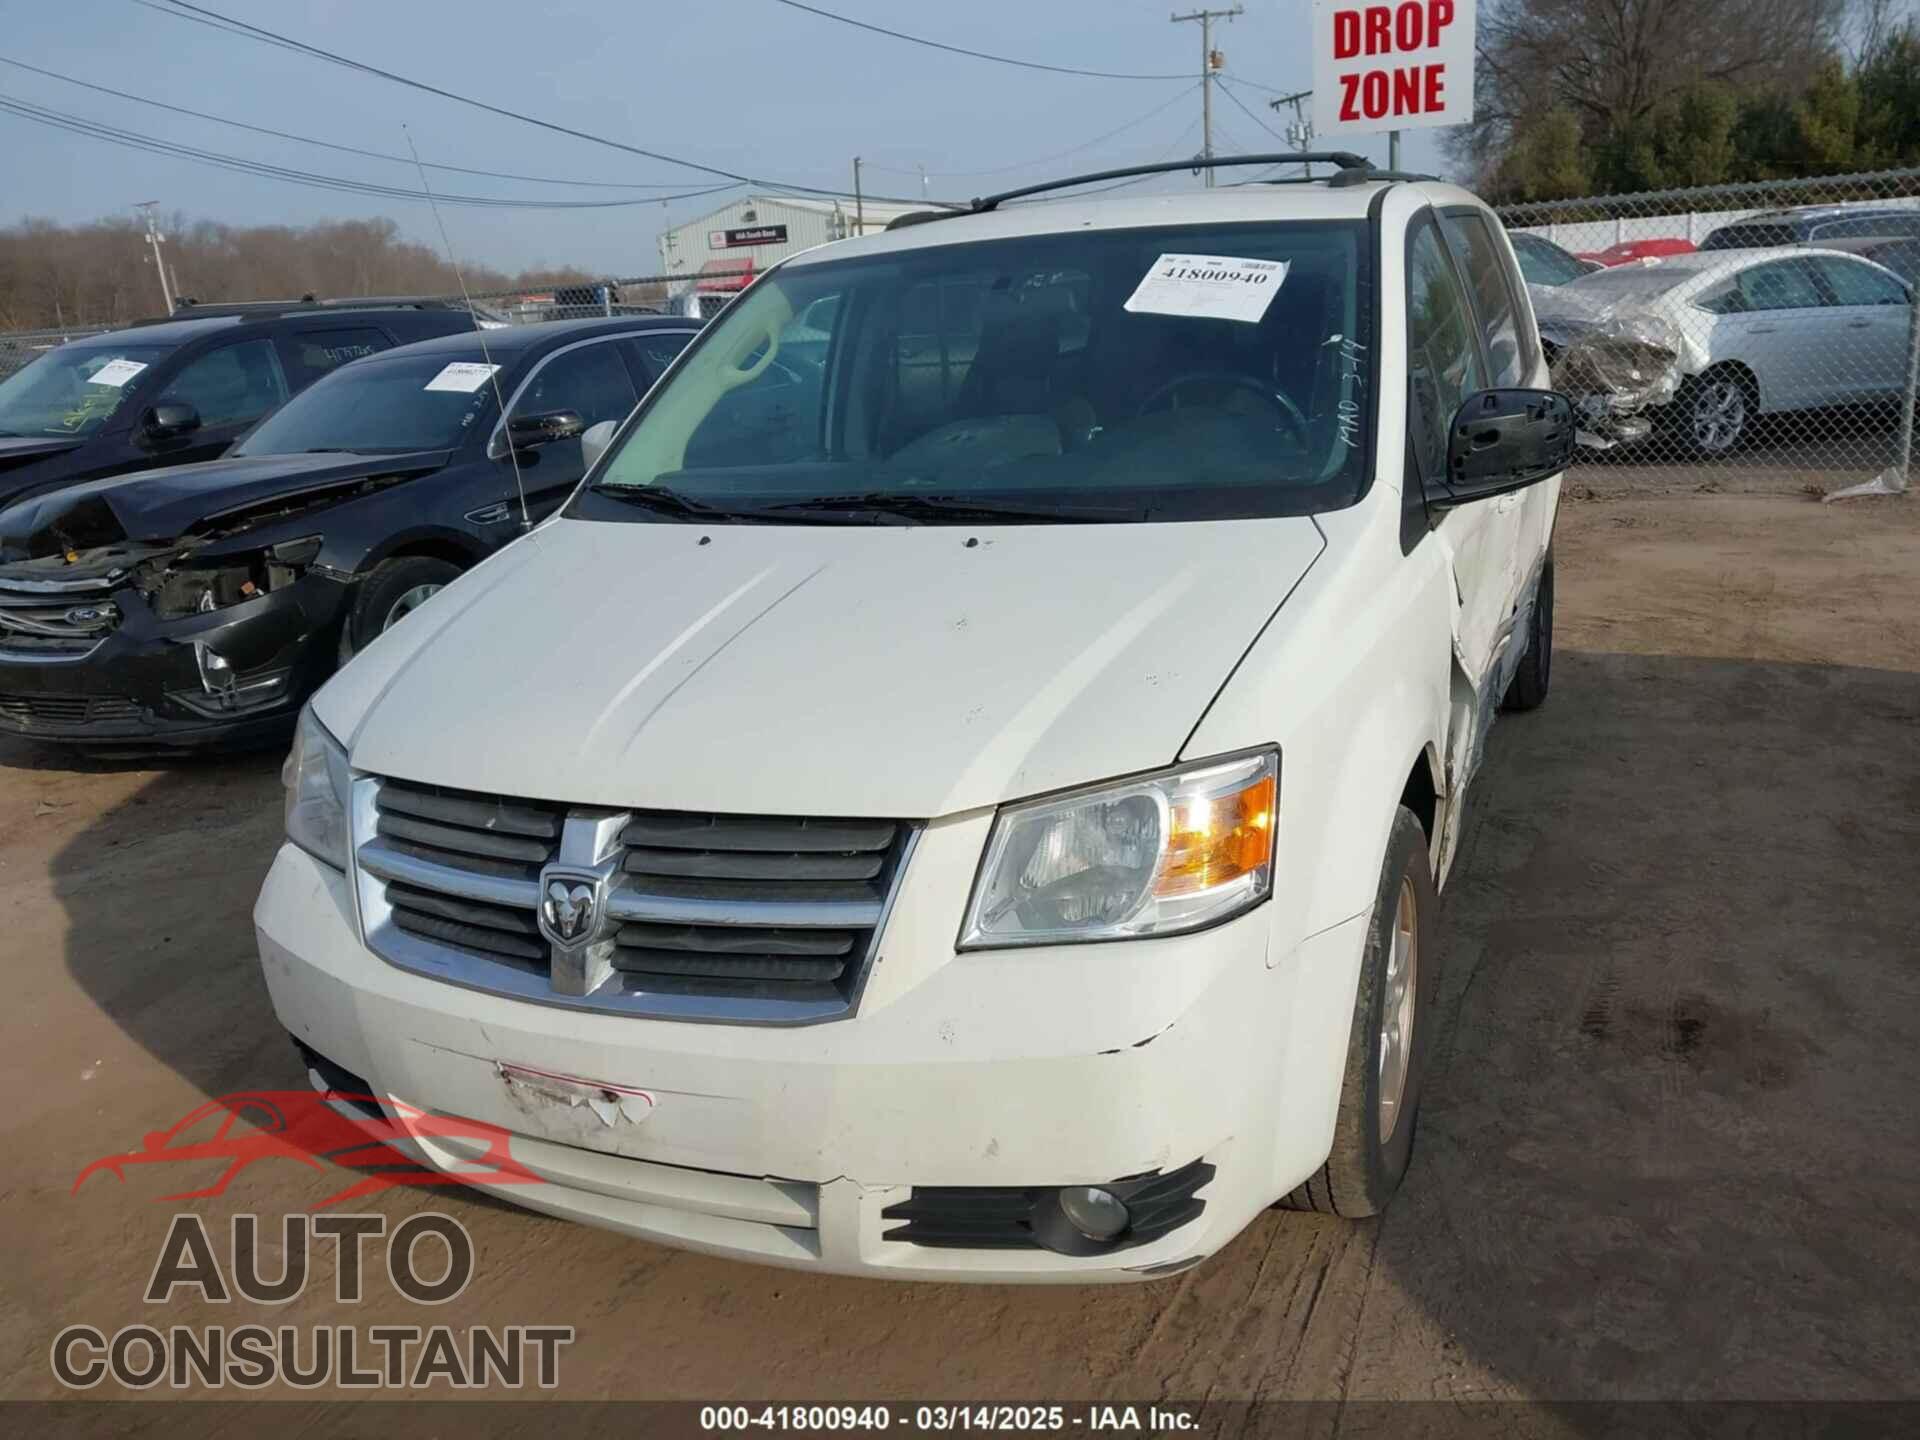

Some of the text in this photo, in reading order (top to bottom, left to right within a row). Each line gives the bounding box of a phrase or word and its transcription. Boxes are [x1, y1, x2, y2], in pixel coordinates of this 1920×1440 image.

[1334, 0, 1455, 60] DROP
[1339, 64, 1446, 122] ZONE
[1161, 266, 1268, 285] 41800940
